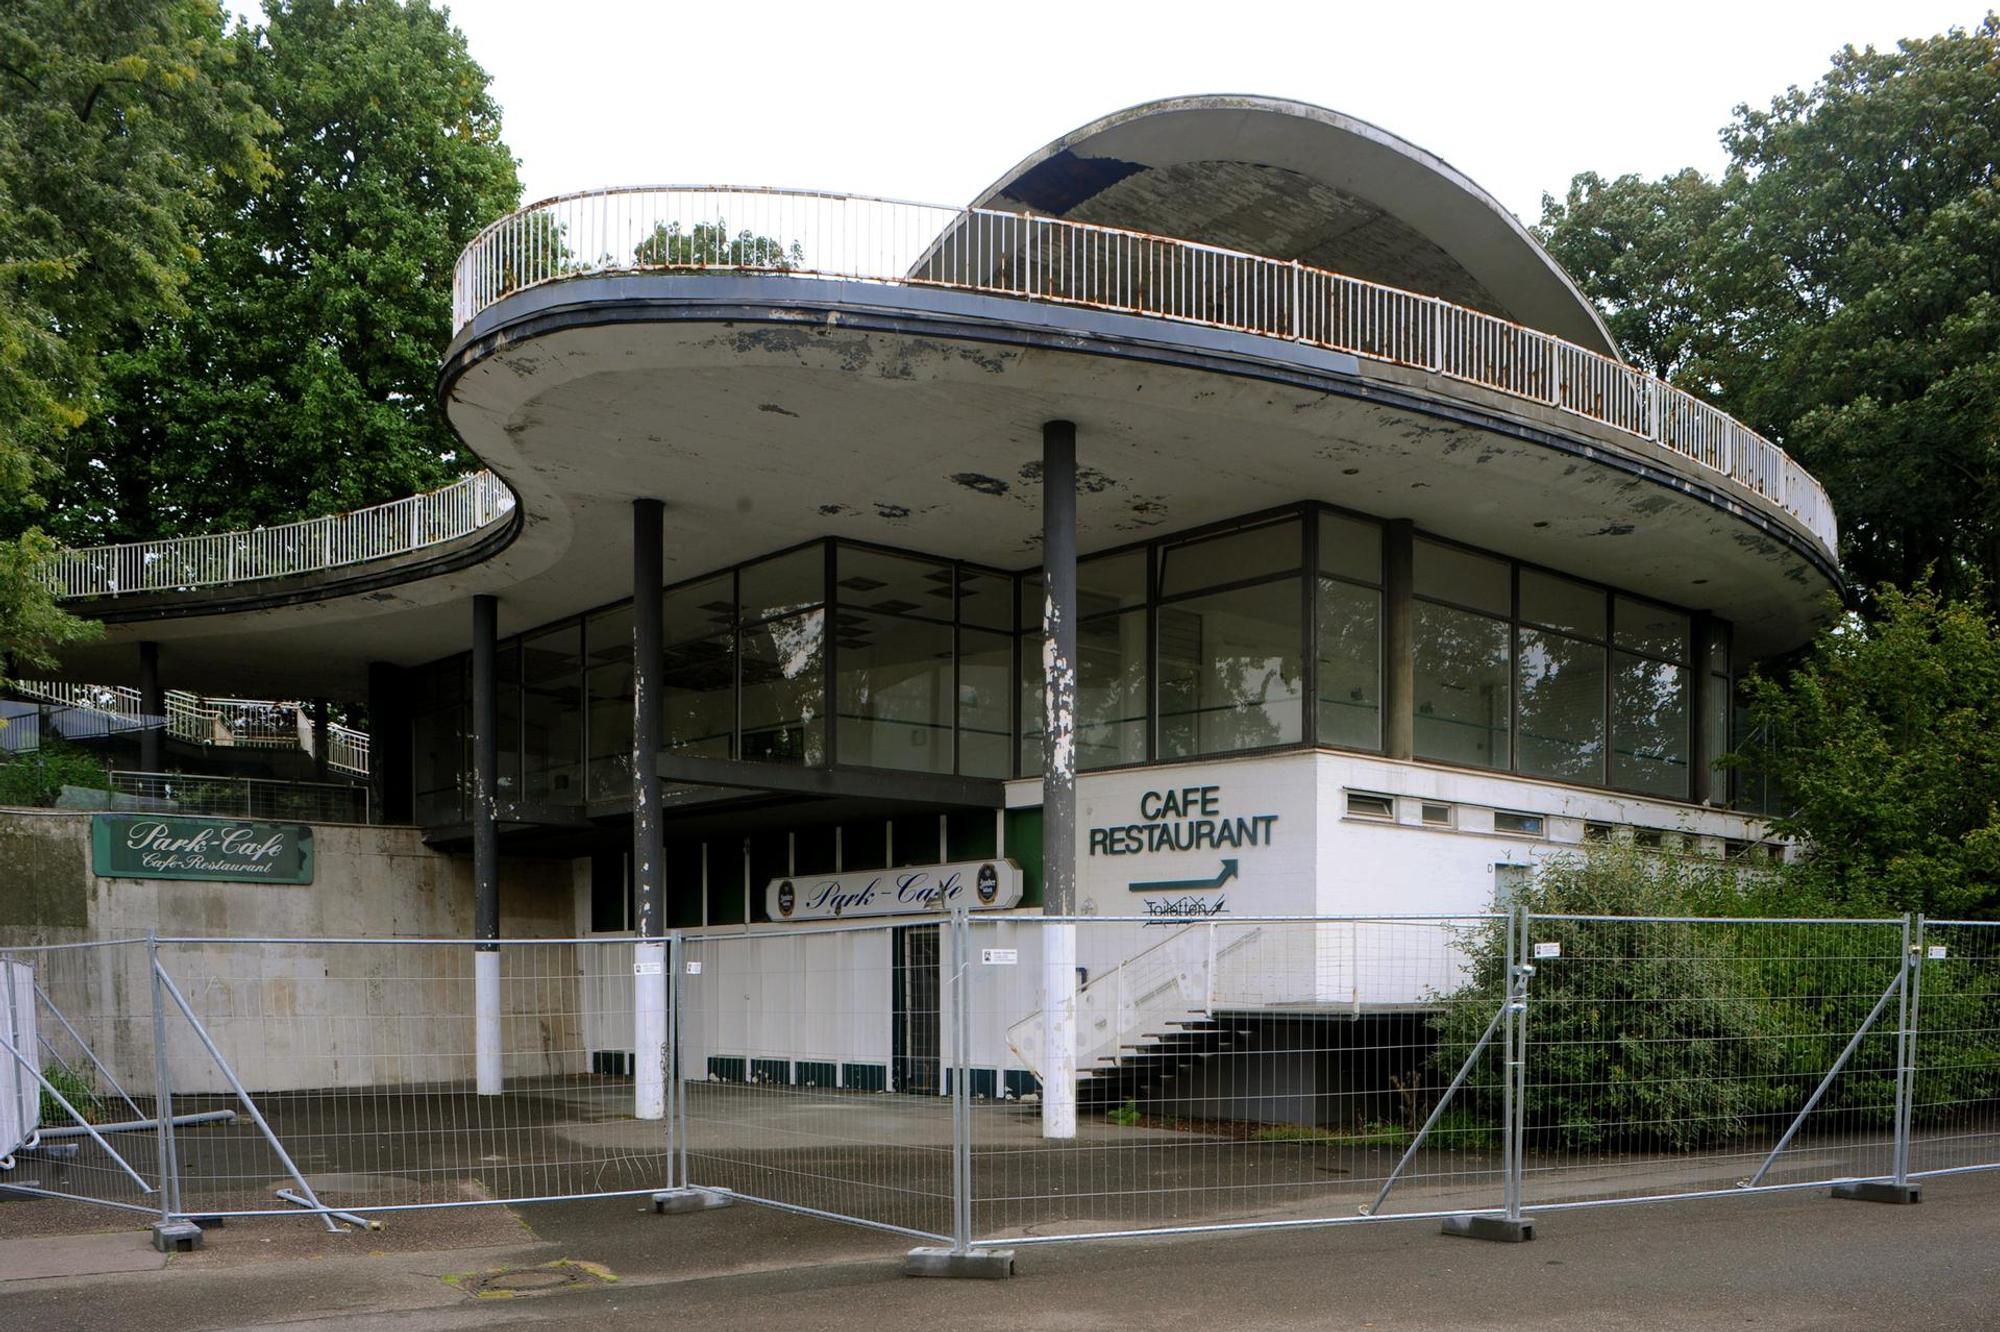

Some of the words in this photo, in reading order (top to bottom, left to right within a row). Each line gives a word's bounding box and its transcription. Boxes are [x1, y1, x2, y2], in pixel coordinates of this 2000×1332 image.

[1141, 786, 1219, 820] CAFE
[127, 822, 284, 860] Park-Cafe
[1090, 815, 1278, 855] RESTAURANT
